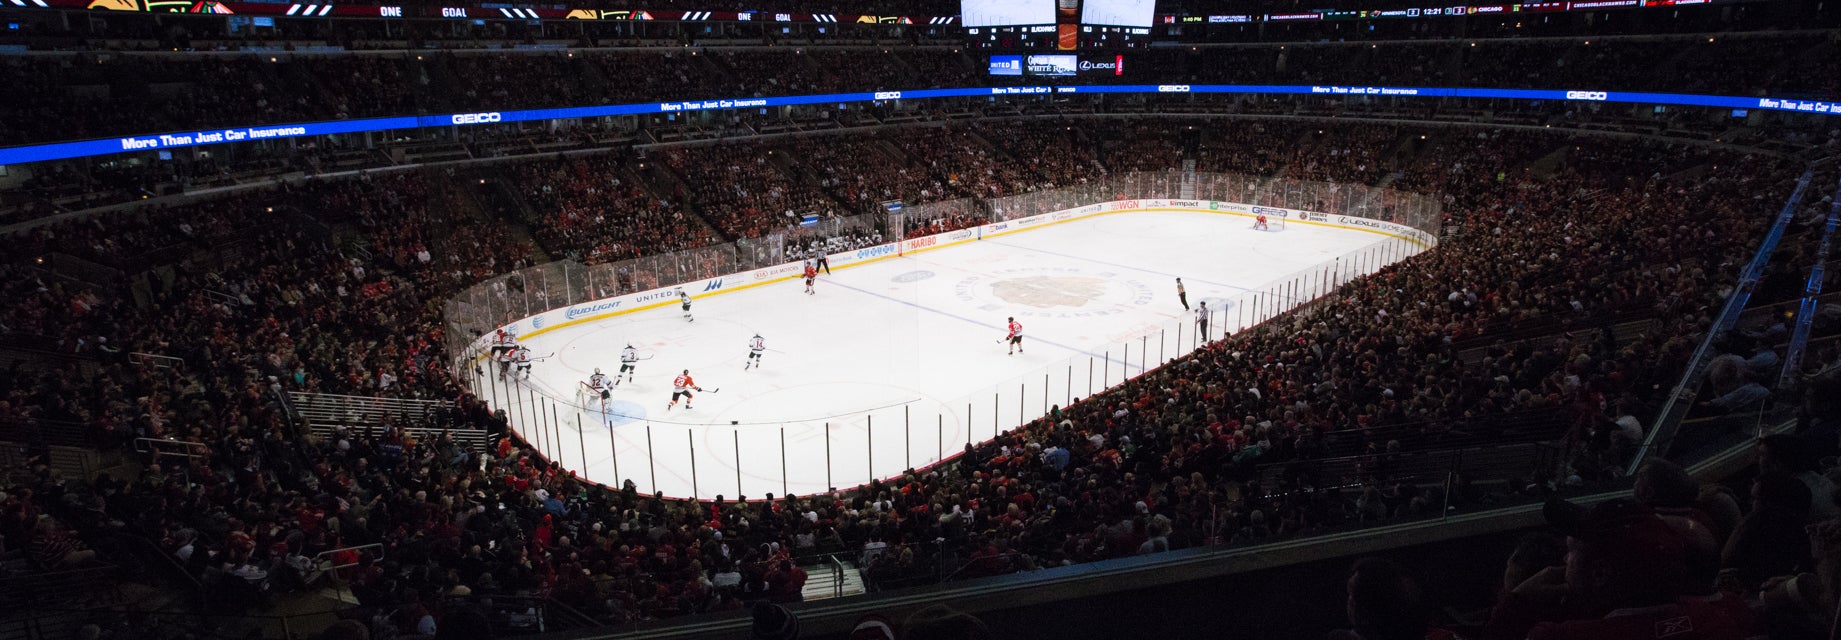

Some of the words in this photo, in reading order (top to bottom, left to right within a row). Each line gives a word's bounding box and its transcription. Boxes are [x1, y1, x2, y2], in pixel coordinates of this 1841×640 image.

[380, 6, 402, 17] ONE
[442, 7, 468, 18] GOAL
[738, 12, 752, 21] ONE
[775, 13, 792, 21] GOAL
[1158, 84, 1190, 92] GEICO
[875, 91, 901, 100] GEICO
[1566, 90, 1607, 100] GEICO
[661, 103, 681, 111] More
[683, 101, 701, 109] Than
[702, 101, 718, 109] Just
[734, 99, 766, 107] Insurance
[1759, 98, 1779, 108] More
[1780, 99, 1797, 110] Than
[1798, 101, 1814, 111] Just
[1815, 102, 1830, 112] Car
[452, 112, 501, 124] GEICO
[121, 137, 158, 150] More
[160, 134, 192, 146] Than
[195, 132, 223, 143] Just
[225, 129, 247, 140] Car
[249, 126, 305, 138] Insurance
[1119, 199, 1139, 210] WGN
[1349, 219, 1379, 228] LEXUS
[911, 236, 937, 249] HARIBO
[636, 291, 673, 303] UNITED
[756, 340, 763, 348] 14
[520, 352, 526, 361] 5
[630, 351, 635, 360] 3
